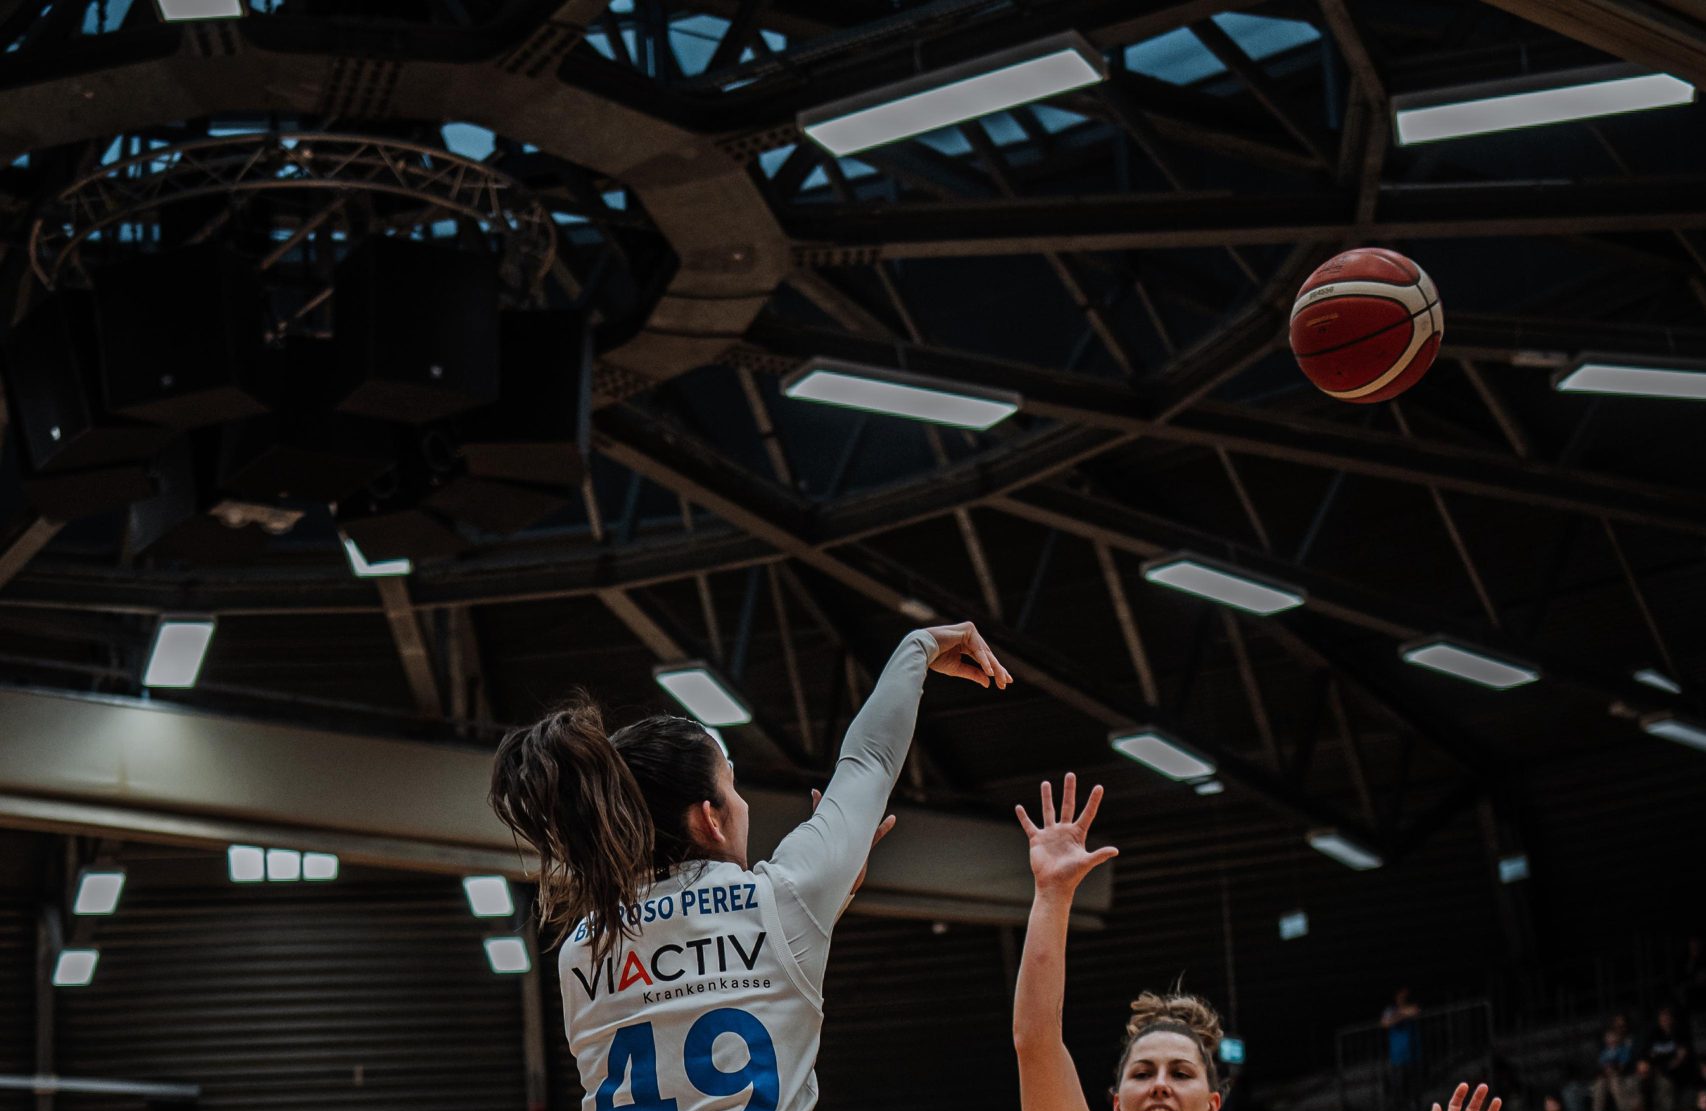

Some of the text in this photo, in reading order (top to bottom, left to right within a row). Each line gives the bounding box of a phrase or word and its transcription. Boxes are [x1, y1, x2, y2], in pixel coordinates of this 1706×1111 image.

[681, 884, 759, 916] PEREZ
[571, 931, 767, 1002] VIACTIV
[643, 977, 771, 1005] Krankenkasse
